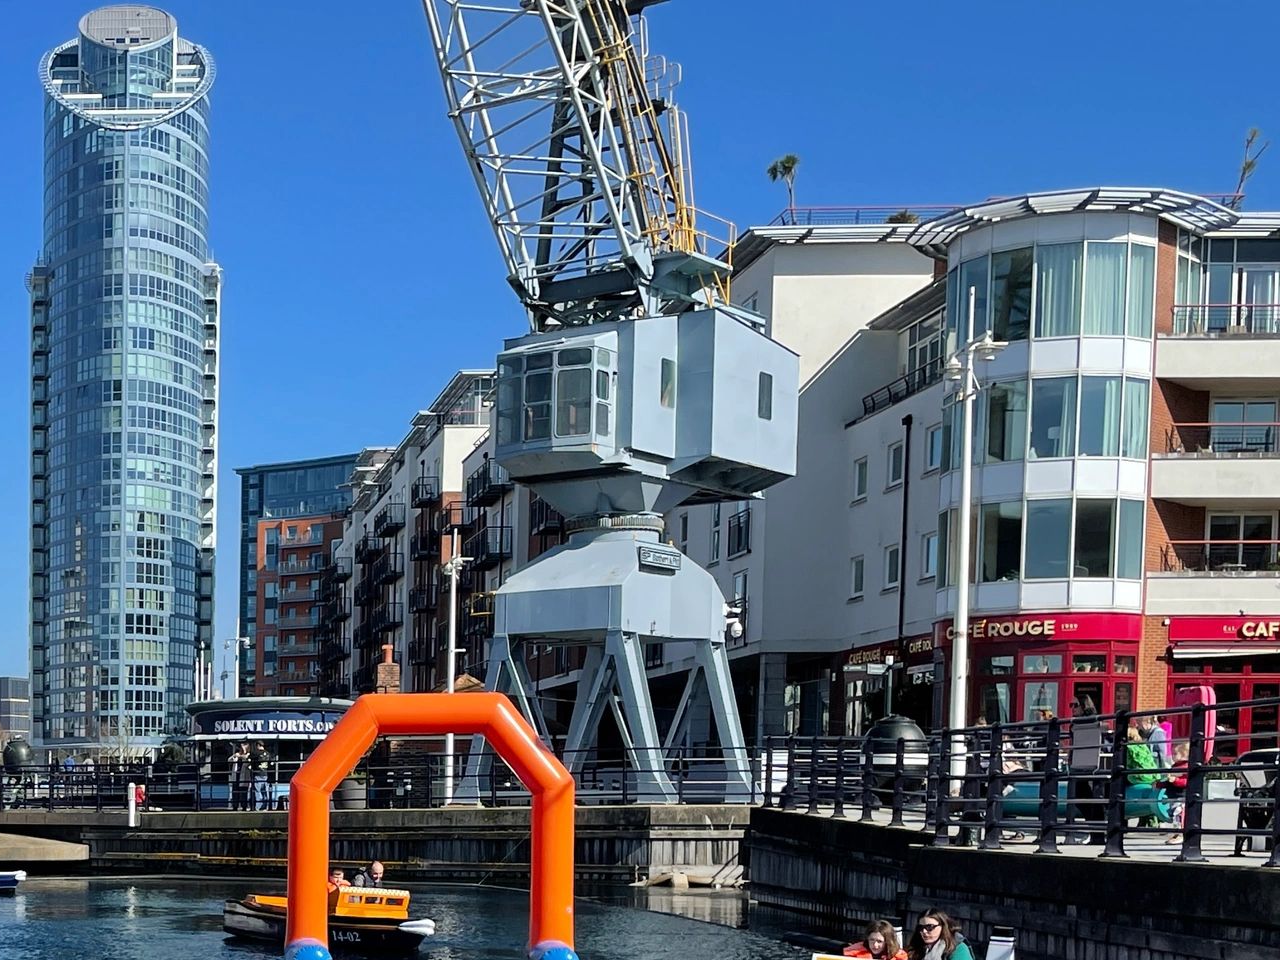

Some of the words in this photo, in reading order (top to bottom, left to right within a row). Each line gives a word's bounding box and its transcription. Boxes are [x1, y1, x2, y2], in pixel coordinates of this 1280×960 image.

[946, 619, 985, 641] CFÉ
[987, 619, 1056, 637] ROUGE
[1241, 621, 1280, 637] CAF
[214, 719, 265, 732] SOLENT
[332, 930, 361, 942] 14-02
